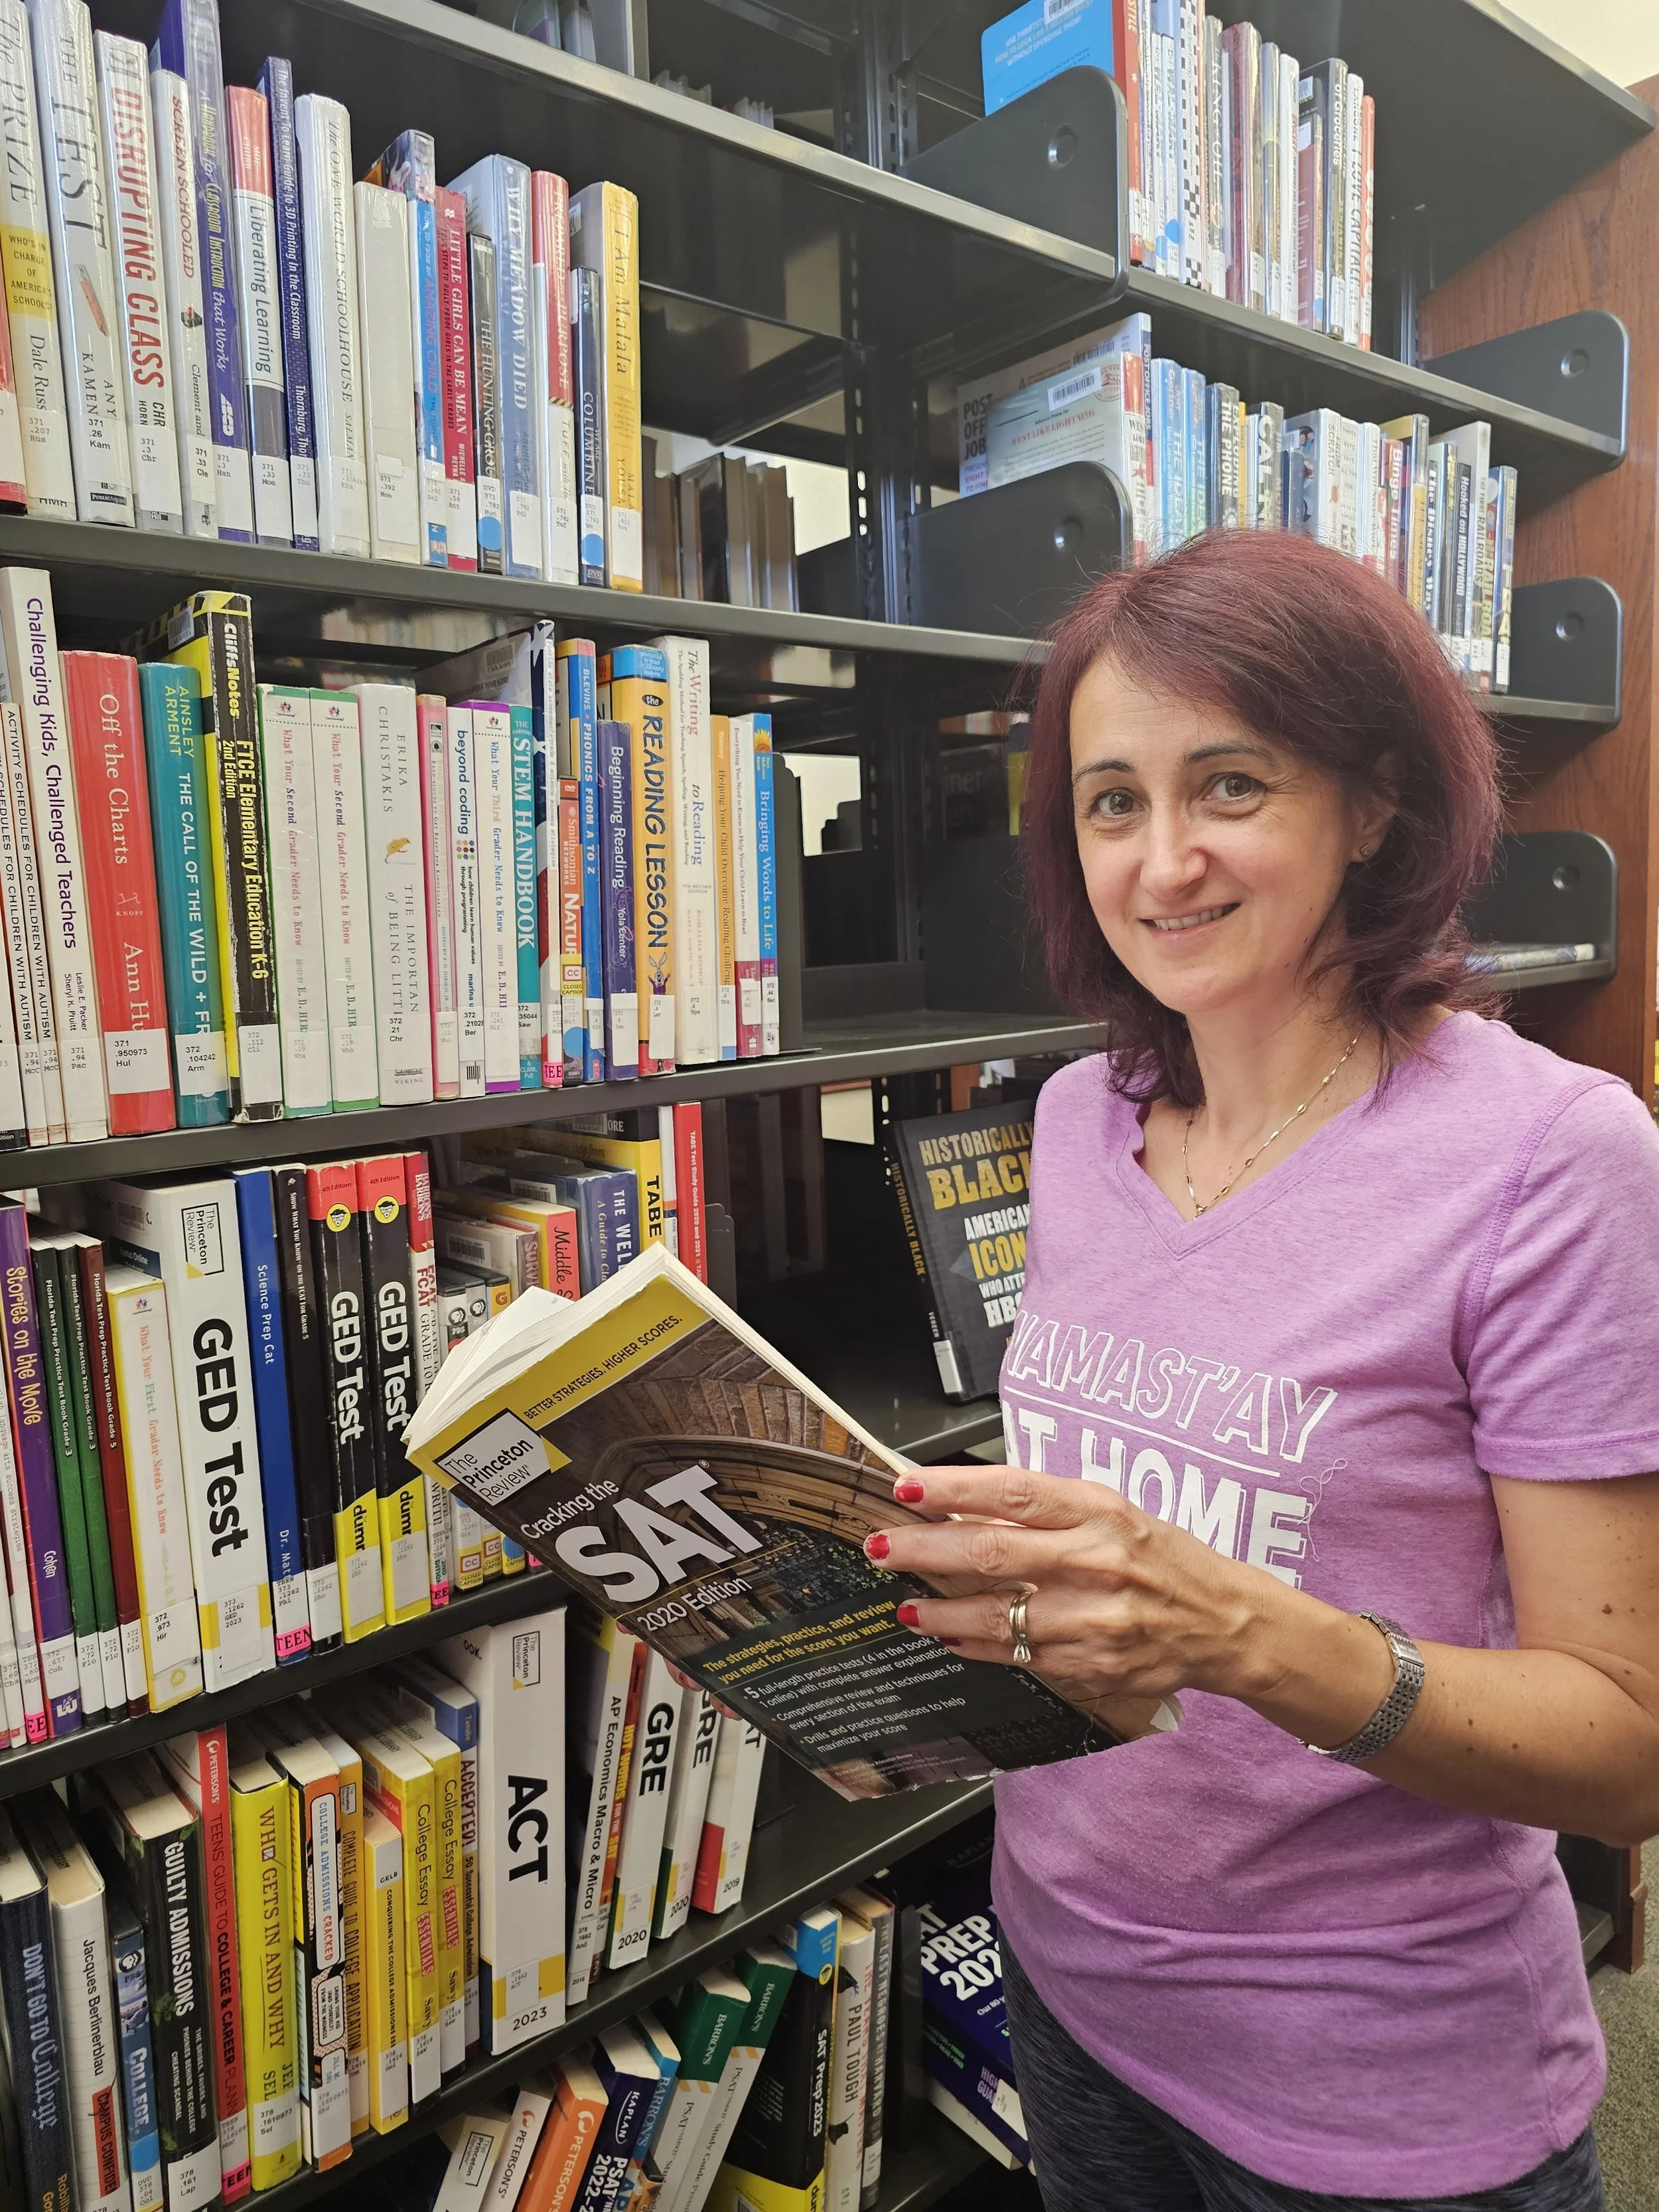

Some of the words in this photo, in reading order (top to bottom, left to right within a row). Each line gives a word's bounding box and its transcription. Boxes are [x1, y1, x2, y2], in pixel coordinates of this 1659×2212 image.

[1, 84, 39, 208] PRIZE
[172, 96, 187, 172] SCREEN
[51, 96, 108, 250] TEST
[111, 86, 158, 283] DISRUPTING
[177, 176, 195, 279] SCHOOLED
[250, 205, 267, 295] Liberating
[13, 250, 46, 266] CHARGE
[27, 269, 37, 278] OF
[450, 229, 462, 283] LITTLE
[452, 287, 463, 331] GIRLS
[30, 334, 47, 372] Dale
[127, 295, 164, 388] CLASS
[255, 299, 273, 374] Learning
[454, 334, 465, 366] CAN
[81, 352, 98, 416] KAMEN
[454, 369, 465, 384] BE
[514, 358, 527, 409] DIED
[88, 418, 104, 428] 371
[89, 429, 103, 439] .26
[138, 400, 147, 425] HORN
[456, 393, 467, 435] MEAN
[90, 440, 111, 450] Kam
[195, 448, 208, 457] 371
[1222, 439, 1232, 496] PHONE
[196, 469, 209, 478] Cle
[1389, 449, 1402, 500] Binge
[1460, 475, 1469, 518] Hooked
[1390, 507, 1398, 560] Times
[1475, 516, 1485, 582] RAILROADS
[26, 598, 52, 707] Challenging
[224, 623, 242, 720] CliffsNotes
[39, 712, 58, 757] Kids,
[99, 693, 122, 739] Off
[164, 685, 182, 757] ARMENT
[178, 686, 195, 759] AINSLEY
[103, 742, 125, 780] the
[222, 741, 234, 762] 2nd
[236, 740, 254, 782] FTCE
[378, 706, 394, 814] CHRISTAKIS
[397, 734, 408, 787] ERIKA
[456, 730, 470, 783] beyond
[512, 737, 531, 800] STEM
[642, 715, 666, 838] READING
[178, 773, 192, 808] THE
[223, 764, 236, 799] Edition
[609, 746, 624, 824] Beginning
[45, 763, 71, 865] Challenged
[109, 786, 128, 865] Charts
[180, 811, 197, 855] CALL
[238, 784, 259, 873] Elementary
[457, 786, 472, 836] coding
[185, 860, 198, 884] OF
[514, 809, 536, 949] HANDBOOK
[613, 827, 628, 889] Reading
[56, 870, 76, 949] Teachers
[186, 889, 202, 922] THE
[244, 873, 263, 950] Education
[644, 841, 670, 949] LESSON
[123, 942, 144, 994] Ann
[188, 928, 208, 984] WILD
[250, 952, 269, 980] K-6
[114, 1048, 148, 1057] .950973
[613, 1189, 626, 1217] THE
[646, 1175, 662, 1238] TABE
[891, 1163, 916, 1238] HISTORICALLY
[910, 1240, 926, 1276] BLACK
[195, 1209, 208, 1265] Princeton
[553, 1226, 574, 1285] Middle
[6, 1266, 28, 1325] Stories
[979, 1280, 1003, 1299] WHO
[14, 1329, 30, 1350] on
[330, 1290, 362, 1363] GED
[15, 1353, 38, 1380] the
[193, 1318, 240, 1433] GED
[523, 1398, 556, 1420] BETTER
[553, 1367, 607, 1403] STRATEGIES.
[603, 1343, 641, 1370] HIGHER
[638, 1315, 684, 1347] SCORES.
[21, 1382, 42, 1426] Move
[336, 1366, 364, 1445] Test
[444, 1453, 478, 1476] The
[465, 1438, 534, 1489] Princeton
[480, 1467, 530, 1507] Review
[204, 1441, 249, 1558] Test
[520, 1493, 595, 1539] Cracking
[585, 1479, 620, 1505] the
[555, 1464, 764, 1603] SAT
[155, 1613, 168, 1623] 372
[156, 1621, 171, 1633] .973
[637, 1601, 688, 1632] 2020
[681, 1577, 753, 1611] Edition
[703, 1660, 727, 1673] The
[725, 1635, 784, 1666] strategies,
[782, 1623, 831, 1648] practice,
[829, 1613, 855, 1631] and
[853, 1599, 897, 1622] review
[718, 1671, 741, 1684] you
[740, 1659, 769, 1676] need
[767, 1652, 785, 1664] for
[783, 1645, 805, 1659] the
[804, 1637, 837, 1653] score
[835, 1631, 860, 1646] you
[859, 1619, 896, 1637] want.
[611, 1695, 622, 1718] AP
[599, 1720, 620, 1802] Economics
[638, 1702, 674, 1797] GRE
[816, 1735, 860, 1753] maximize
[859, 1729, 882, 1742] your
[881, 1724, 908, 1736] score
[416, 1803, 431, 1862] College
[506, 1774, 549, 1883] ACT
[592, 1805, 608, 1850] Macro
[165, 1841, 187, 1903] GUILTY
[380, 1871, 398, 1884] GELB
[590, 1853, 599, 1866] &
[722, 1876, 741, 1895] 2019
[261, 1866, 279, 1918] GETS
[416, 1865, 431, 1907] Essay
[584, 1868, 599, 1911] Micro
[263, 1920, 281, 1947] IN
[416, 1911, 435, 1976] ESSENTIALS
[617, 1929, 648, 1951] 2020
[920, 1914, 992, 1975] PREP
[22, 1942, 46, 1988] DON'T
[82, 1939, 97, 1994] Jacques
[167, 1907, 194, 2018] ADMISSIONS
[265, 1951, 282, 1995] AND
[27, 1989, 46, 2018] GO
[268, 1999, 285, 2049] WHY
[512, 2006, 548, 2031] 2023
[847, 2004, 863, 2049] PAUL
[28, 2019, 46, 2041] TO
[88, 1994, 104, 2077] Berlinerblau
[703, 2012, 727, 2067] BARRON'S
[844, 2052, 860, 2104] TOUGH
[618, 2091, 640, 2138] KAPLAN
[180, 2169, 194, 2179] 378
